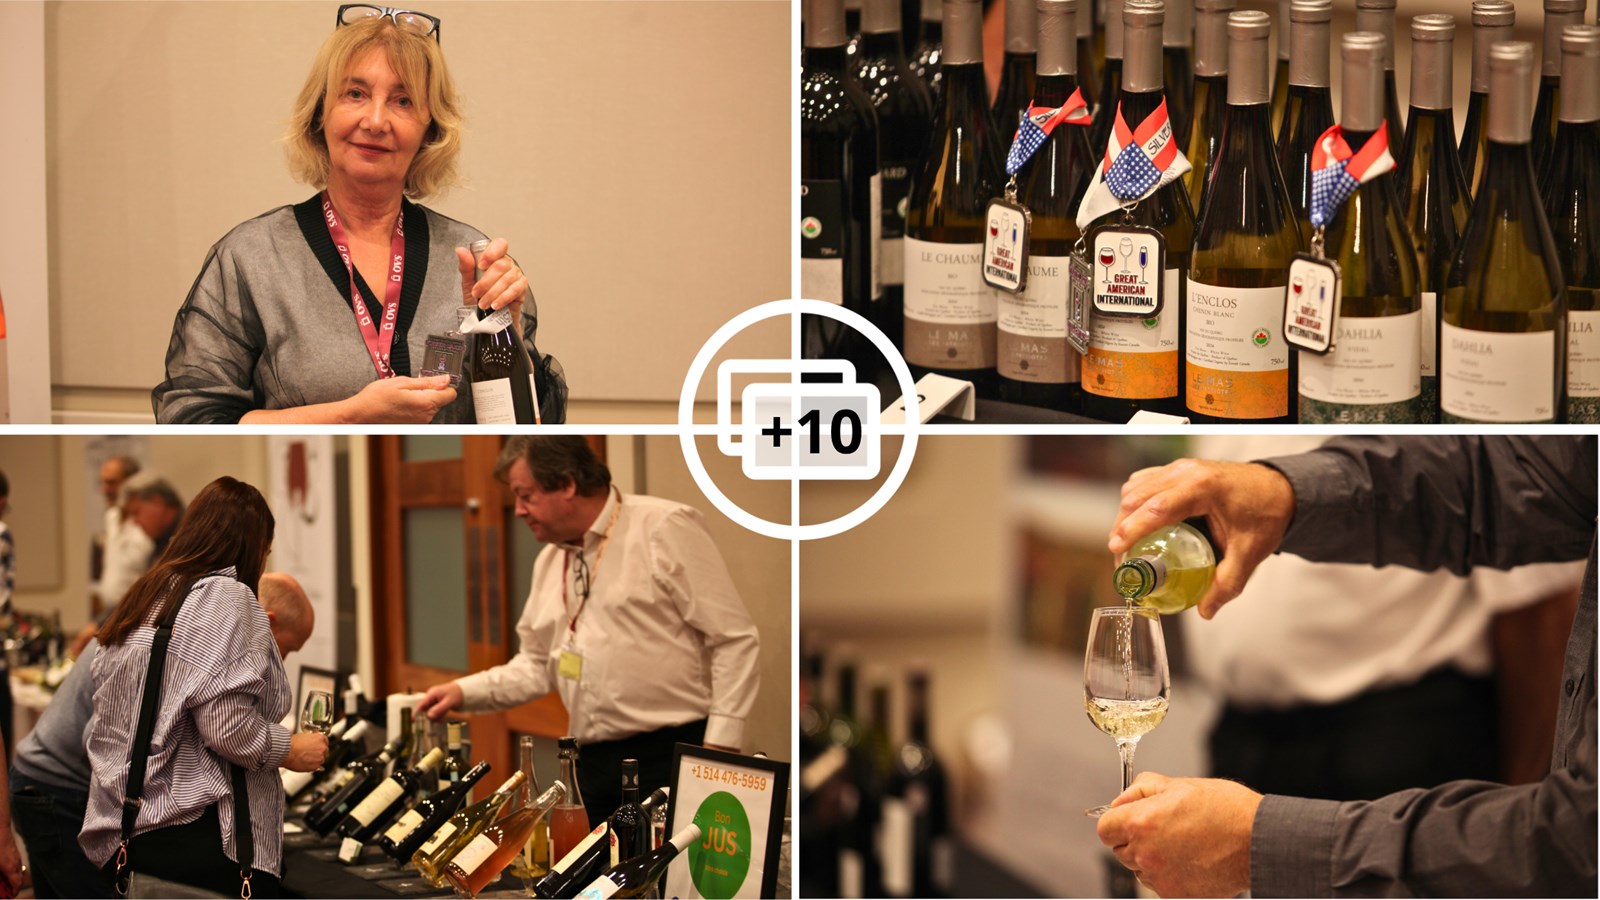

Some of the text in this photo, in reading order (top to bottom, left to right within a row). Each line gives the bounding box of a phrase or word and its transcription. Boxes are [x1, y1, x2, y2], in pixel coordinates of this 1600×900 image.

[921, 252, 983, 265] LE CHAUM
[1028, 266, 1059, 277] AUME
[1114, 274, 1138, 284] GREAT
[1107, 284, 1145, 295] AMERICAN
[1097, 294, 1154, 307] INTERNATIONAL
[1191, 292, 1237, 309] L'ENCLOS
[1213, 311, 1235, 319] BLANC
[692, 765, 767, 791] +1 514 476-5959
[714, 810, 731, 824] Bon
[703, 826, 737, 856] JUS
